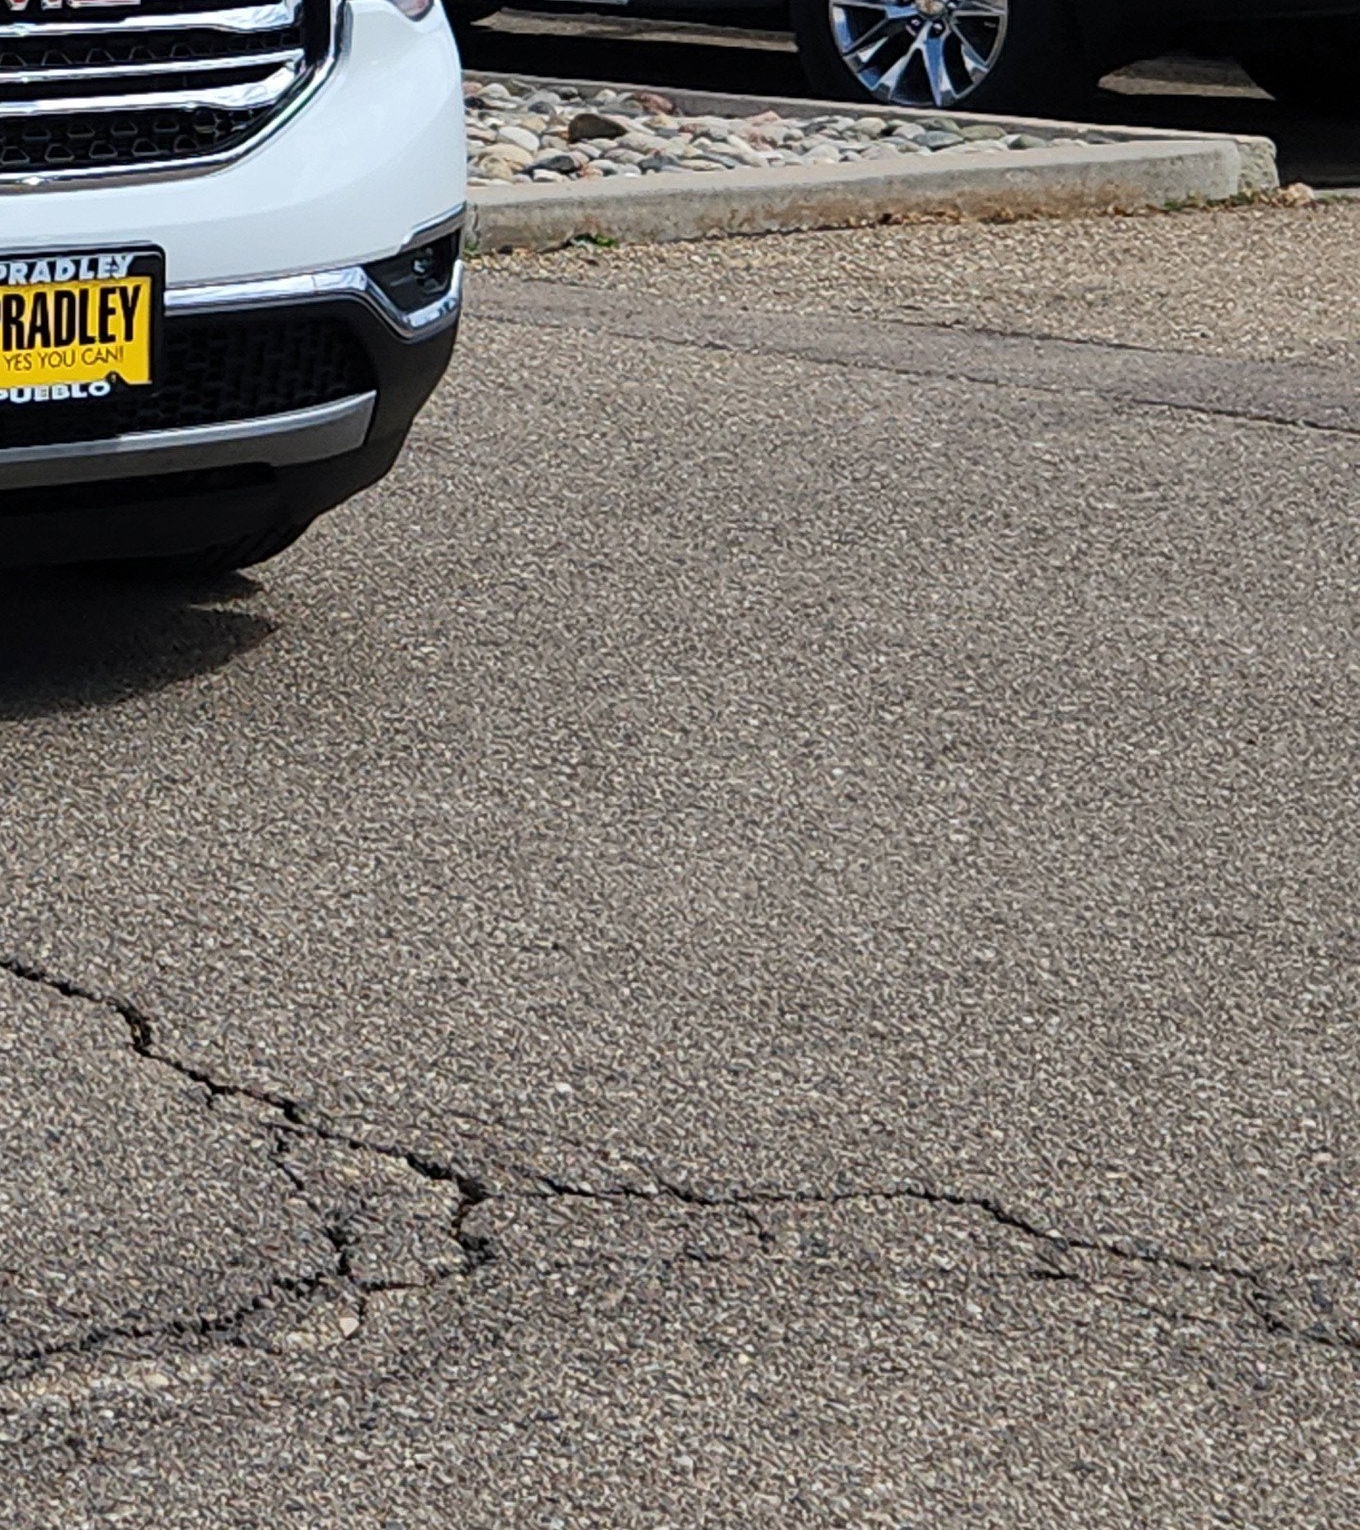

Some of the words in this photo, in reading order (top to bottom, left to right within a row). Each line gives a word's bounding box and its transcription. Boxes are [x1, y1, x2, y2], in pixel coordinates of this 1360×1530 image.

[3, 353, 33, 372] YES
[38, 349, 76, 369] YOU
[81, 345, 124, 365] CAN!
